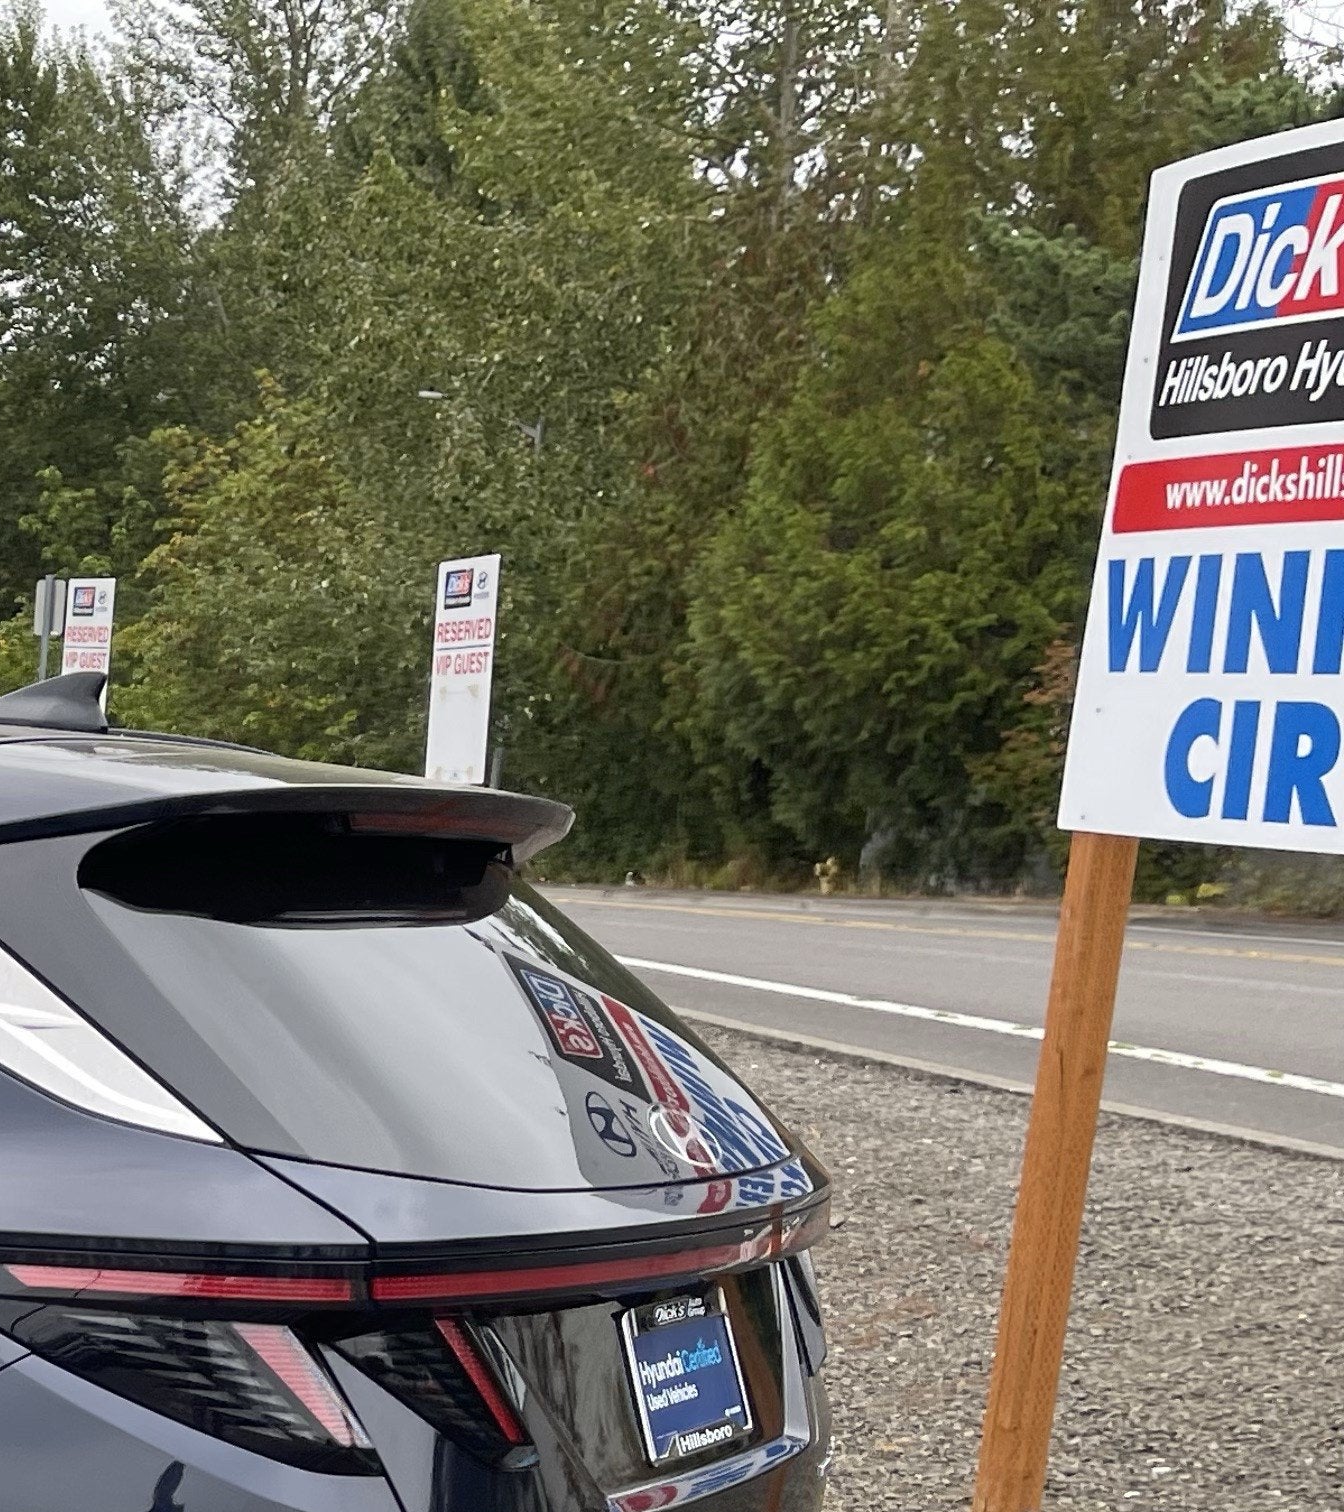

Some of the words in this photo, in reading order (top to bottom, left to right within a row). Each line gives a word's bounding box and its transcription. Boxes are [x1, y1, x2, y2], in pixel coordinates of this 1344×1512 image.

[1189, 193, 1344, 319] Dick
[1158, 351, 1289, 407] Hillsboro
[1165, 452, 1344, 510] www.dickshill
[436, 617, 492, 643] RESERVED
[454, 651, 490, 675] GUEST
[1165, 697, 1342, 827] CIR
[679, 1424, 734, 1453] Hillsboro
